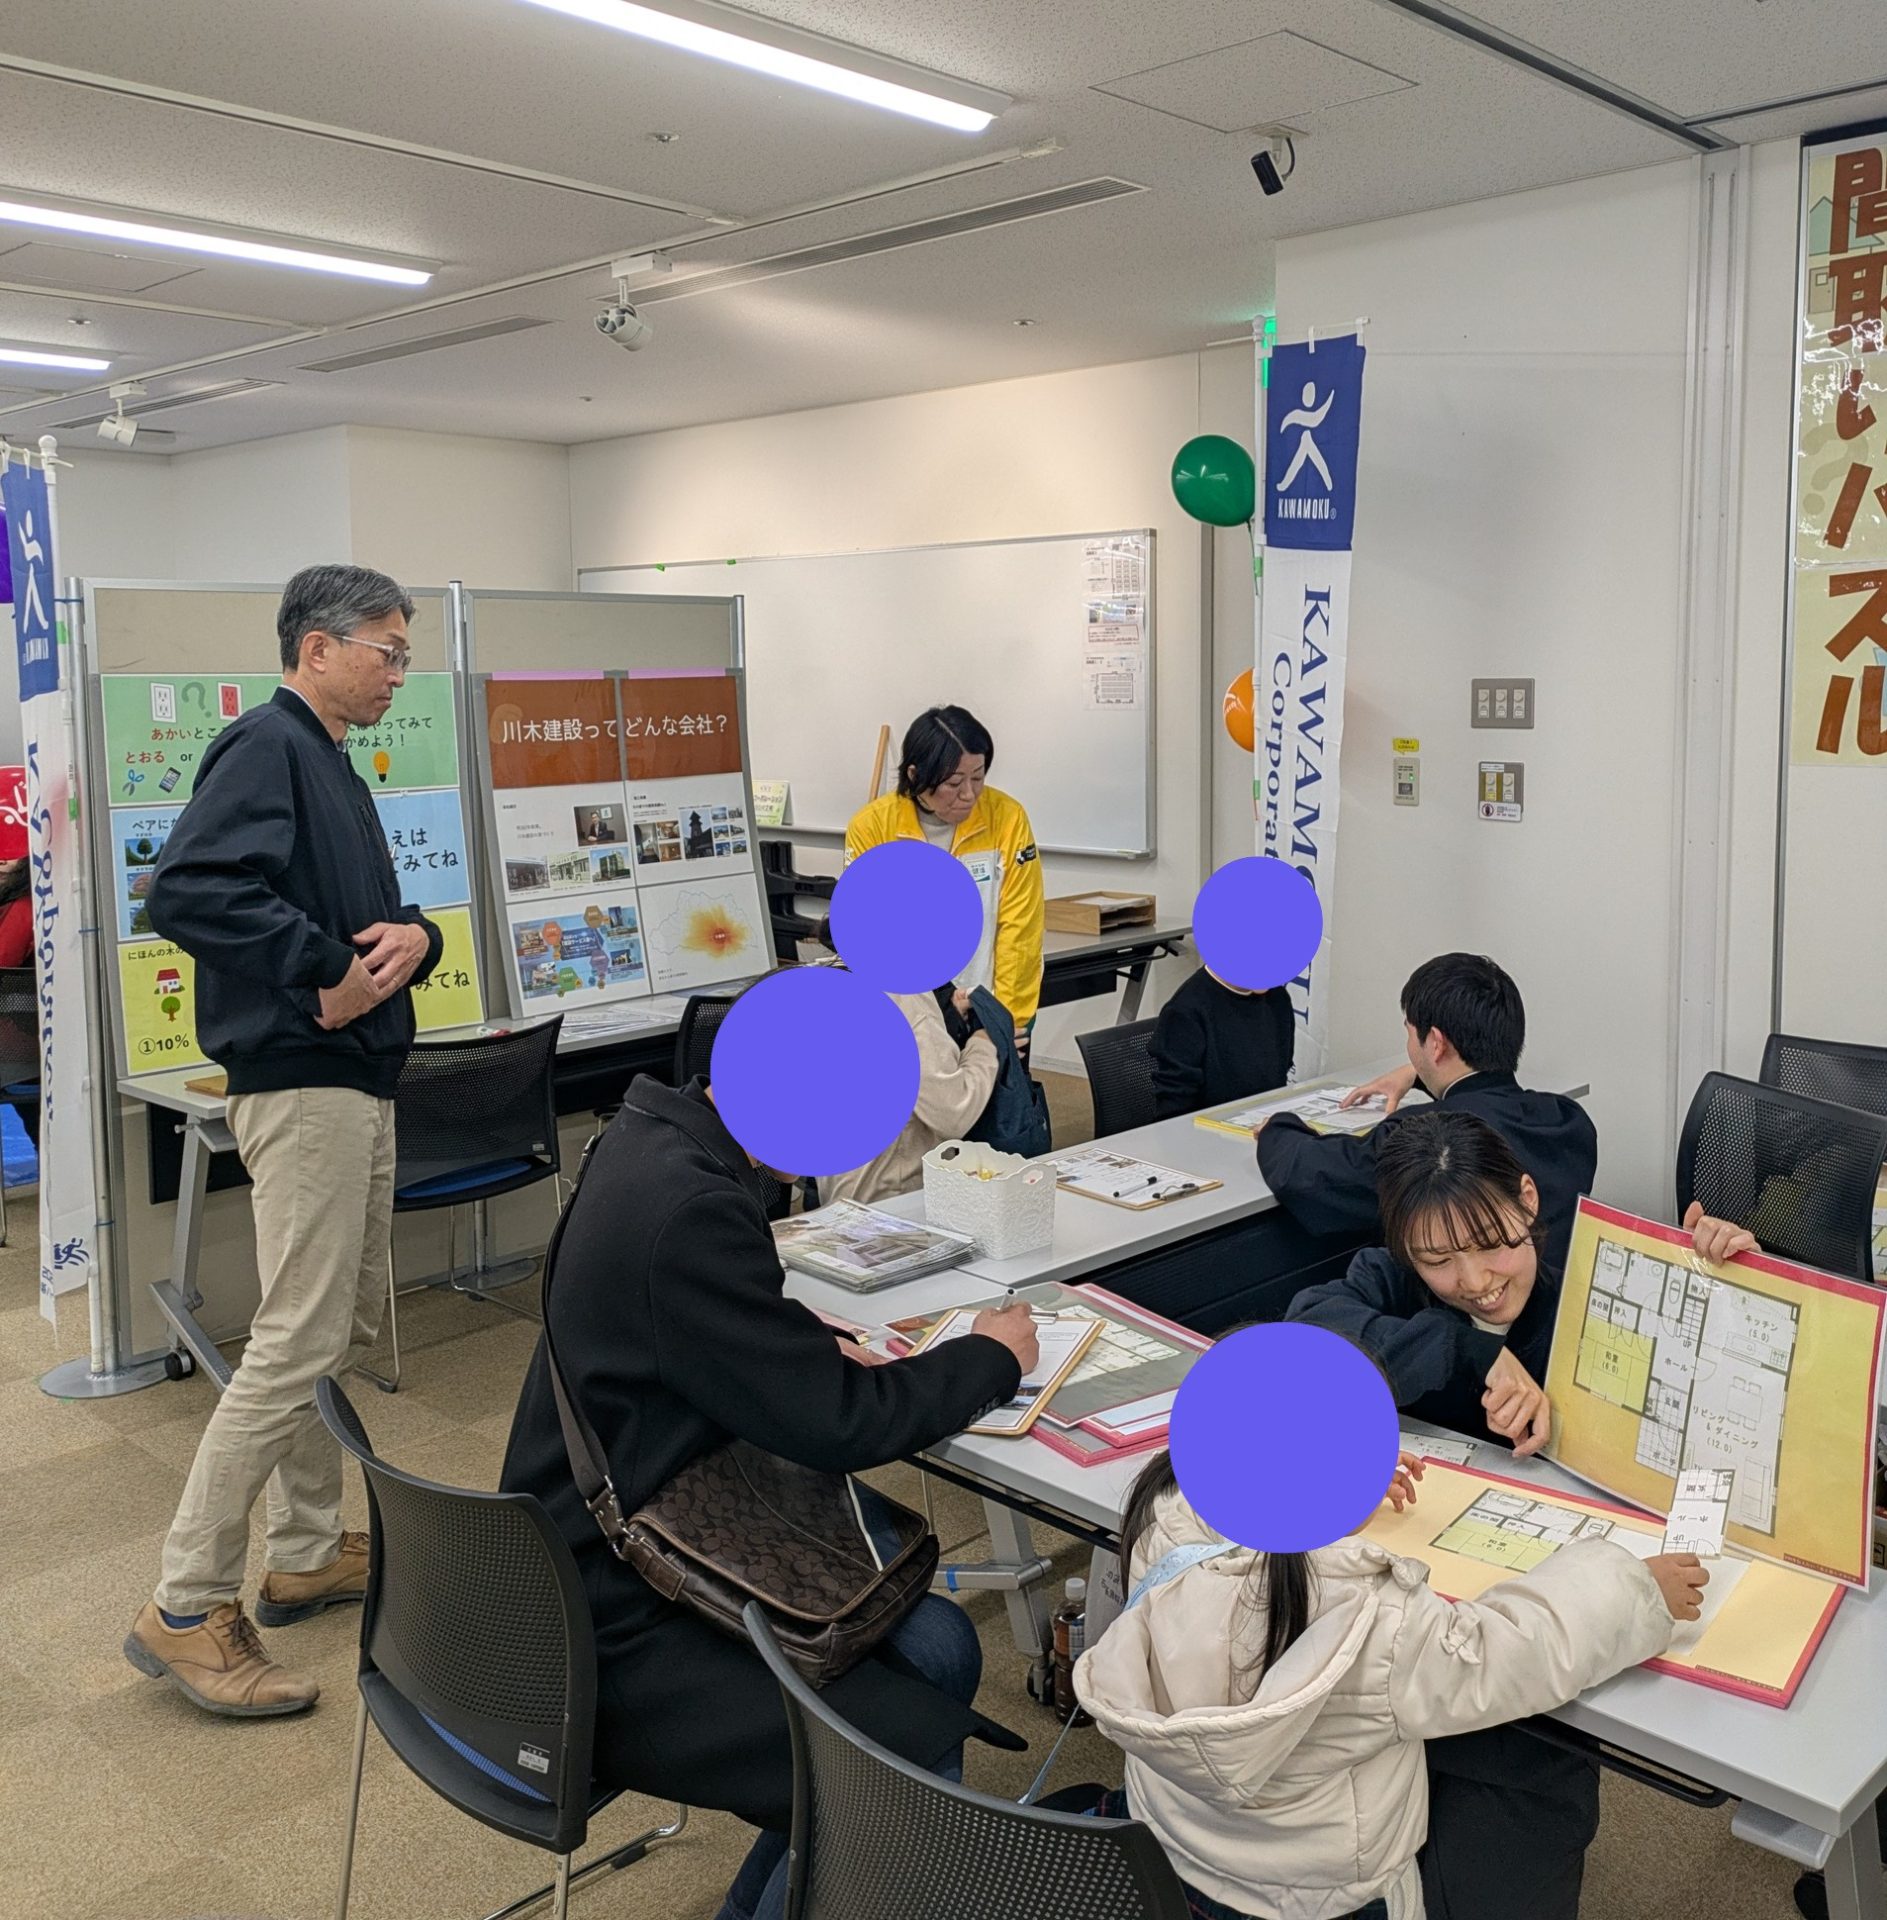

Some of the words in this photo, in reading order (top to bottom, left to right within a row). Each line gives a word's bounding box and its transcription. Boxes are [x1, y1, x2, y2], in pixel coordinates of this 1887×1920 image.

[151, 727, 227, 741] あかいとこ
[126, 750, 165, 764] とおる
[180, 753, 193, 762] or
[1745, 1314, 1778, 1332] キッチン
